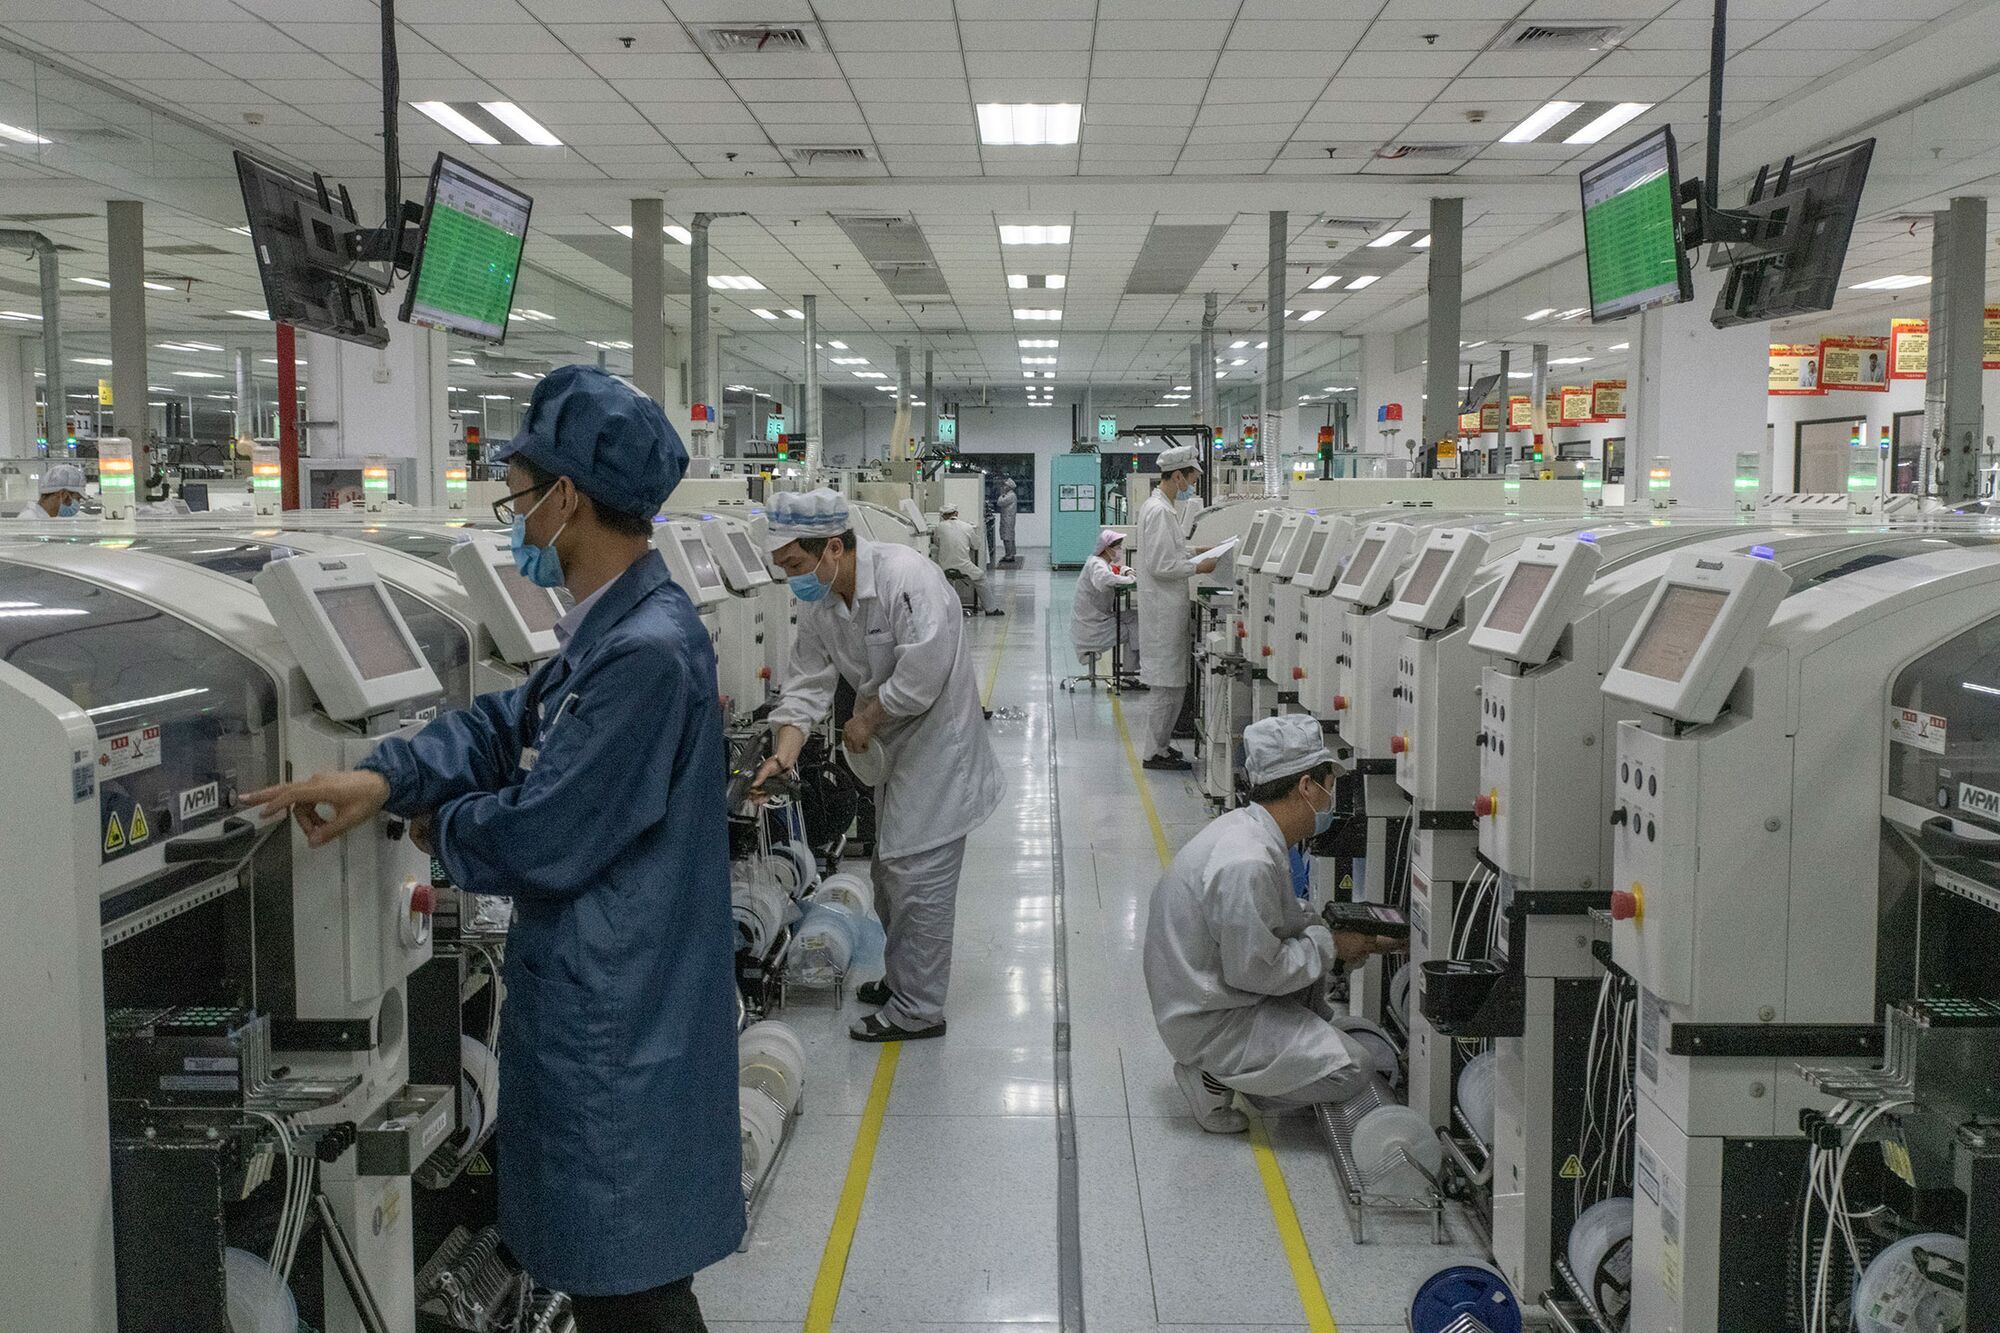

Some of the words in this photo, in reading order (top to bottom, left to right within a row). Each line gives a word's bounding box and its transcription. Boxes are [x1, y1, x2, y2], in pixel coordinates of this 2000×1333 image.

[77, 420, 89, 429] 11
[452, 423, 459, 433] 7
[947, 424, 953, 434] 4
[1101, 424, 1106, 435] 3
[183, 785, 216, 812] NPM
[1962, 787, 2000, 813] NPM
